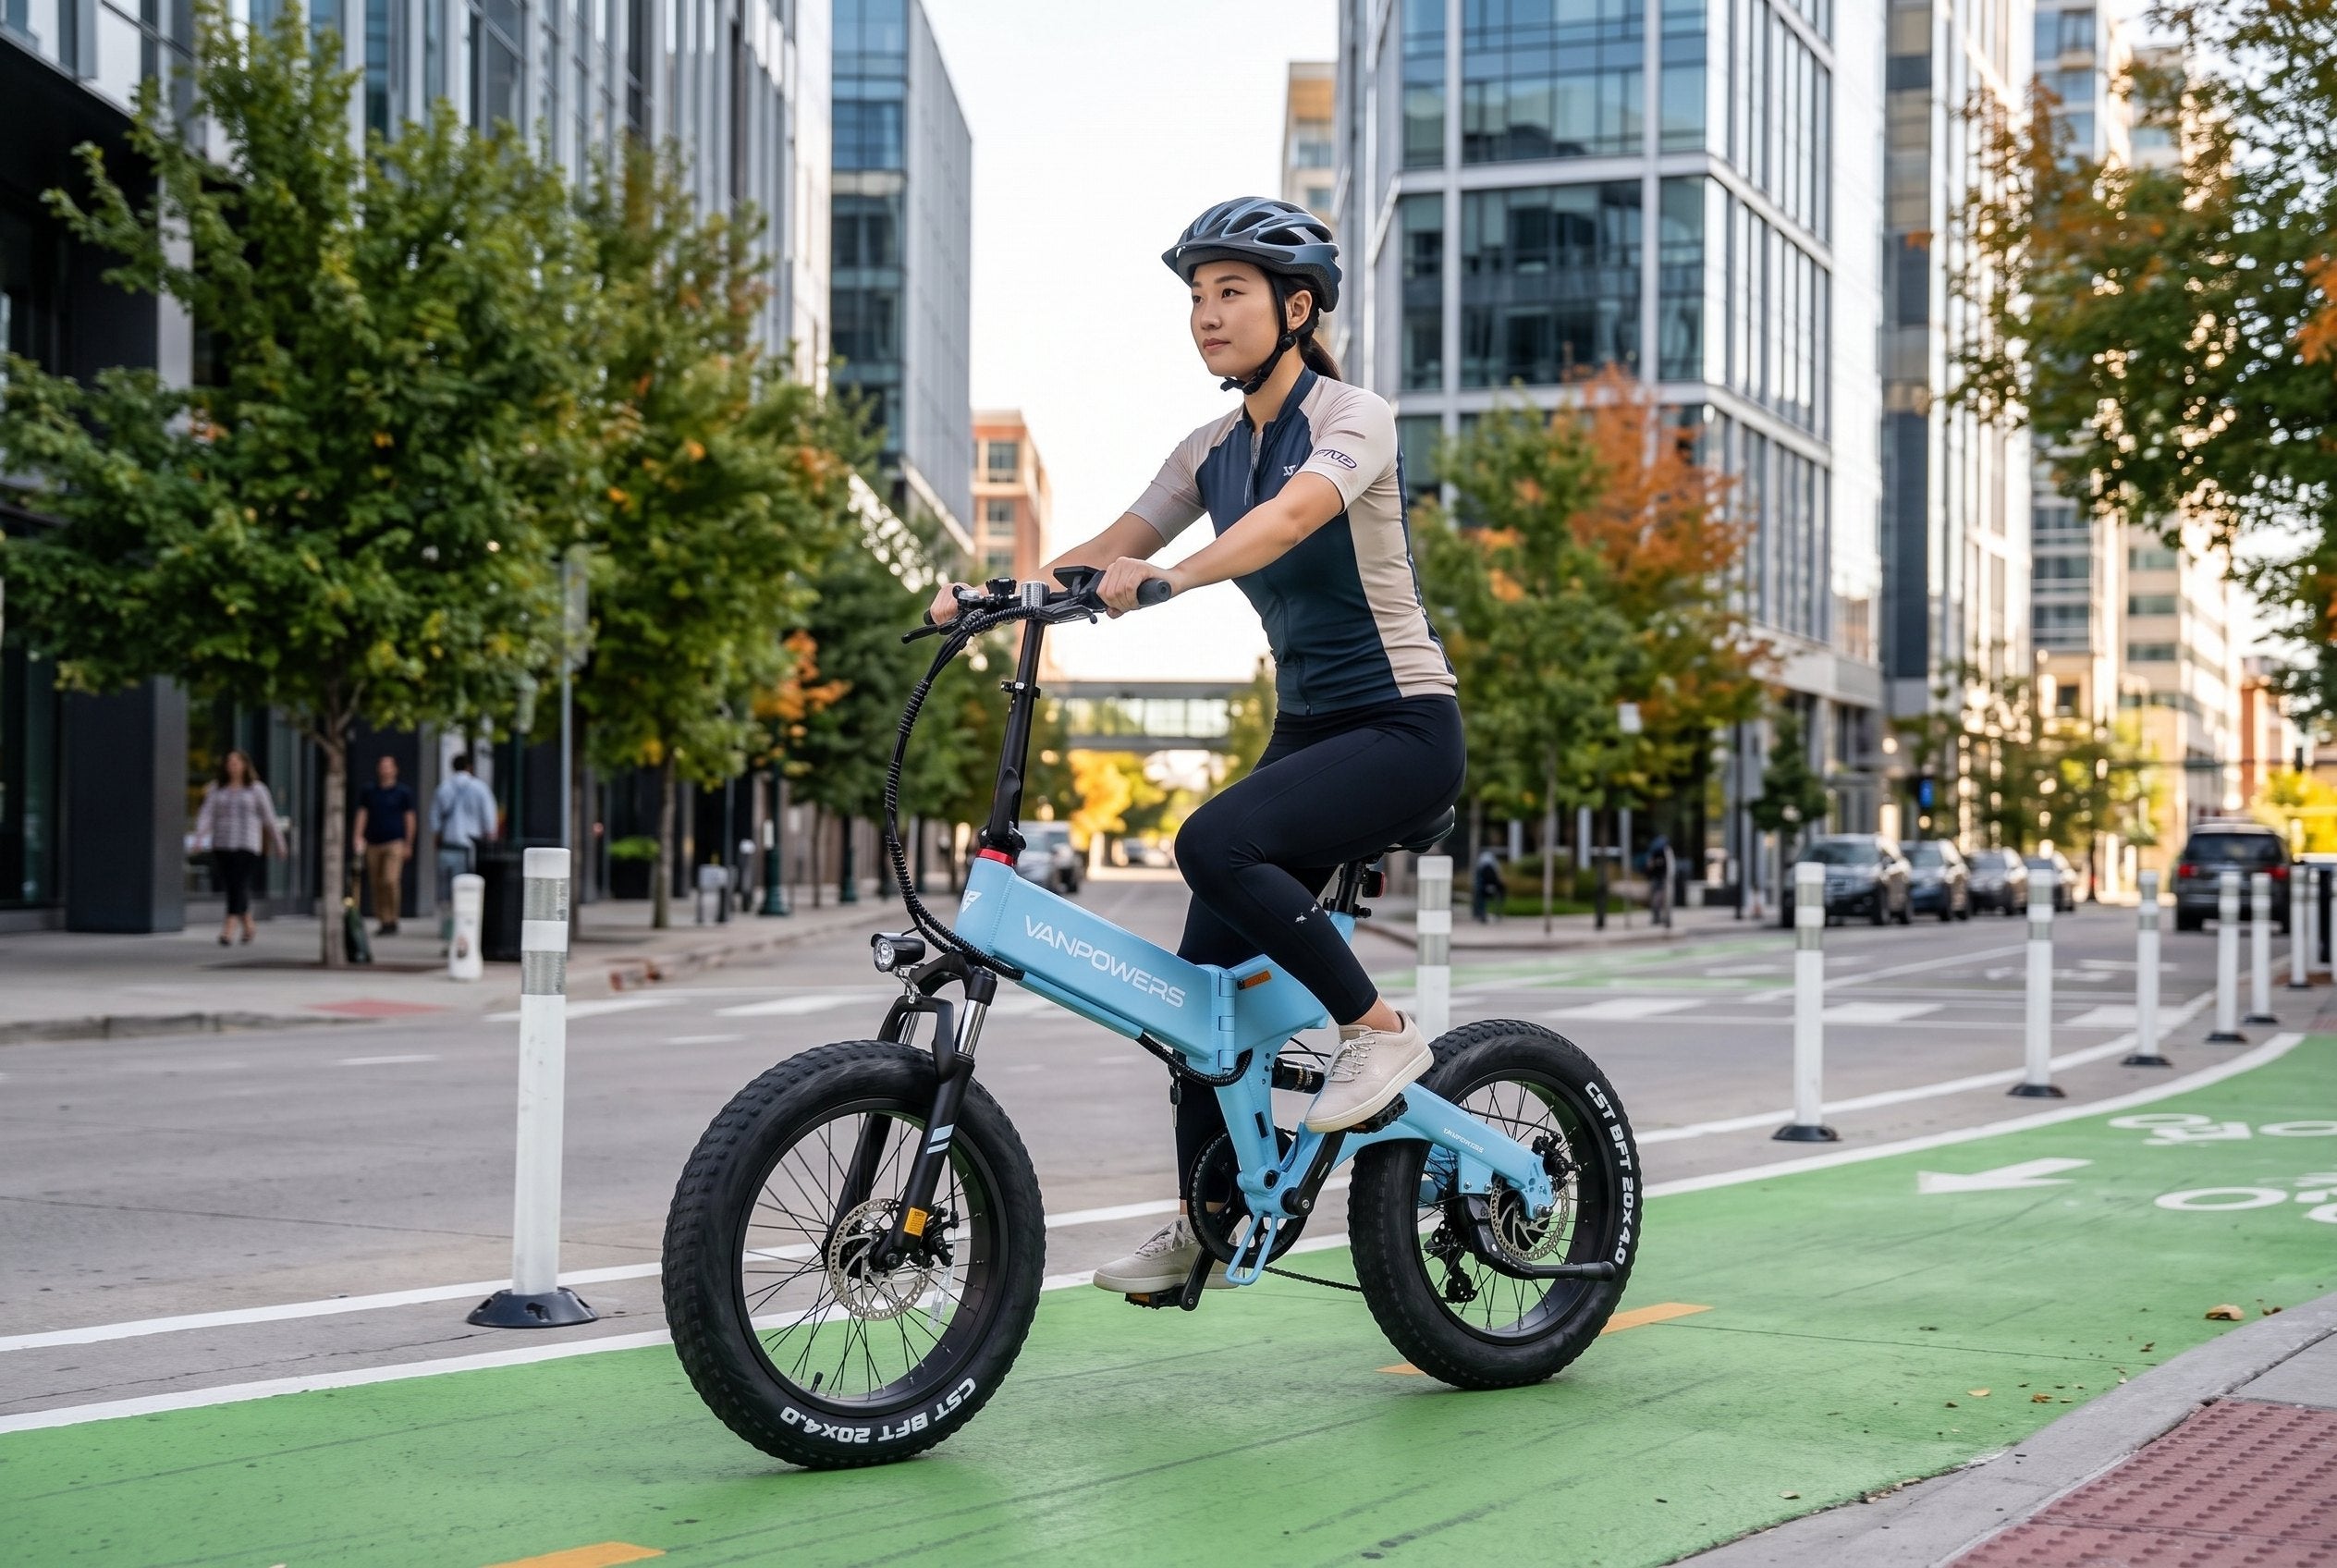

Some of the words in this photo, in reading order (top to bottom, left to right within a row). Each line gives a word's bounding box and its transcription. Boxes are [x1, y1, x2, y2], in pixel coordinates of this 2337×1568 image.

[1024, 914, 1186, 1009] VANPOWERS
[1585, 1081, 1616, 1120] CST
[1609, 1123, 1633, 1170] BFT
[877, 1412, 929, 1442] BFT
[935, 1378, 976, 1422] CST
